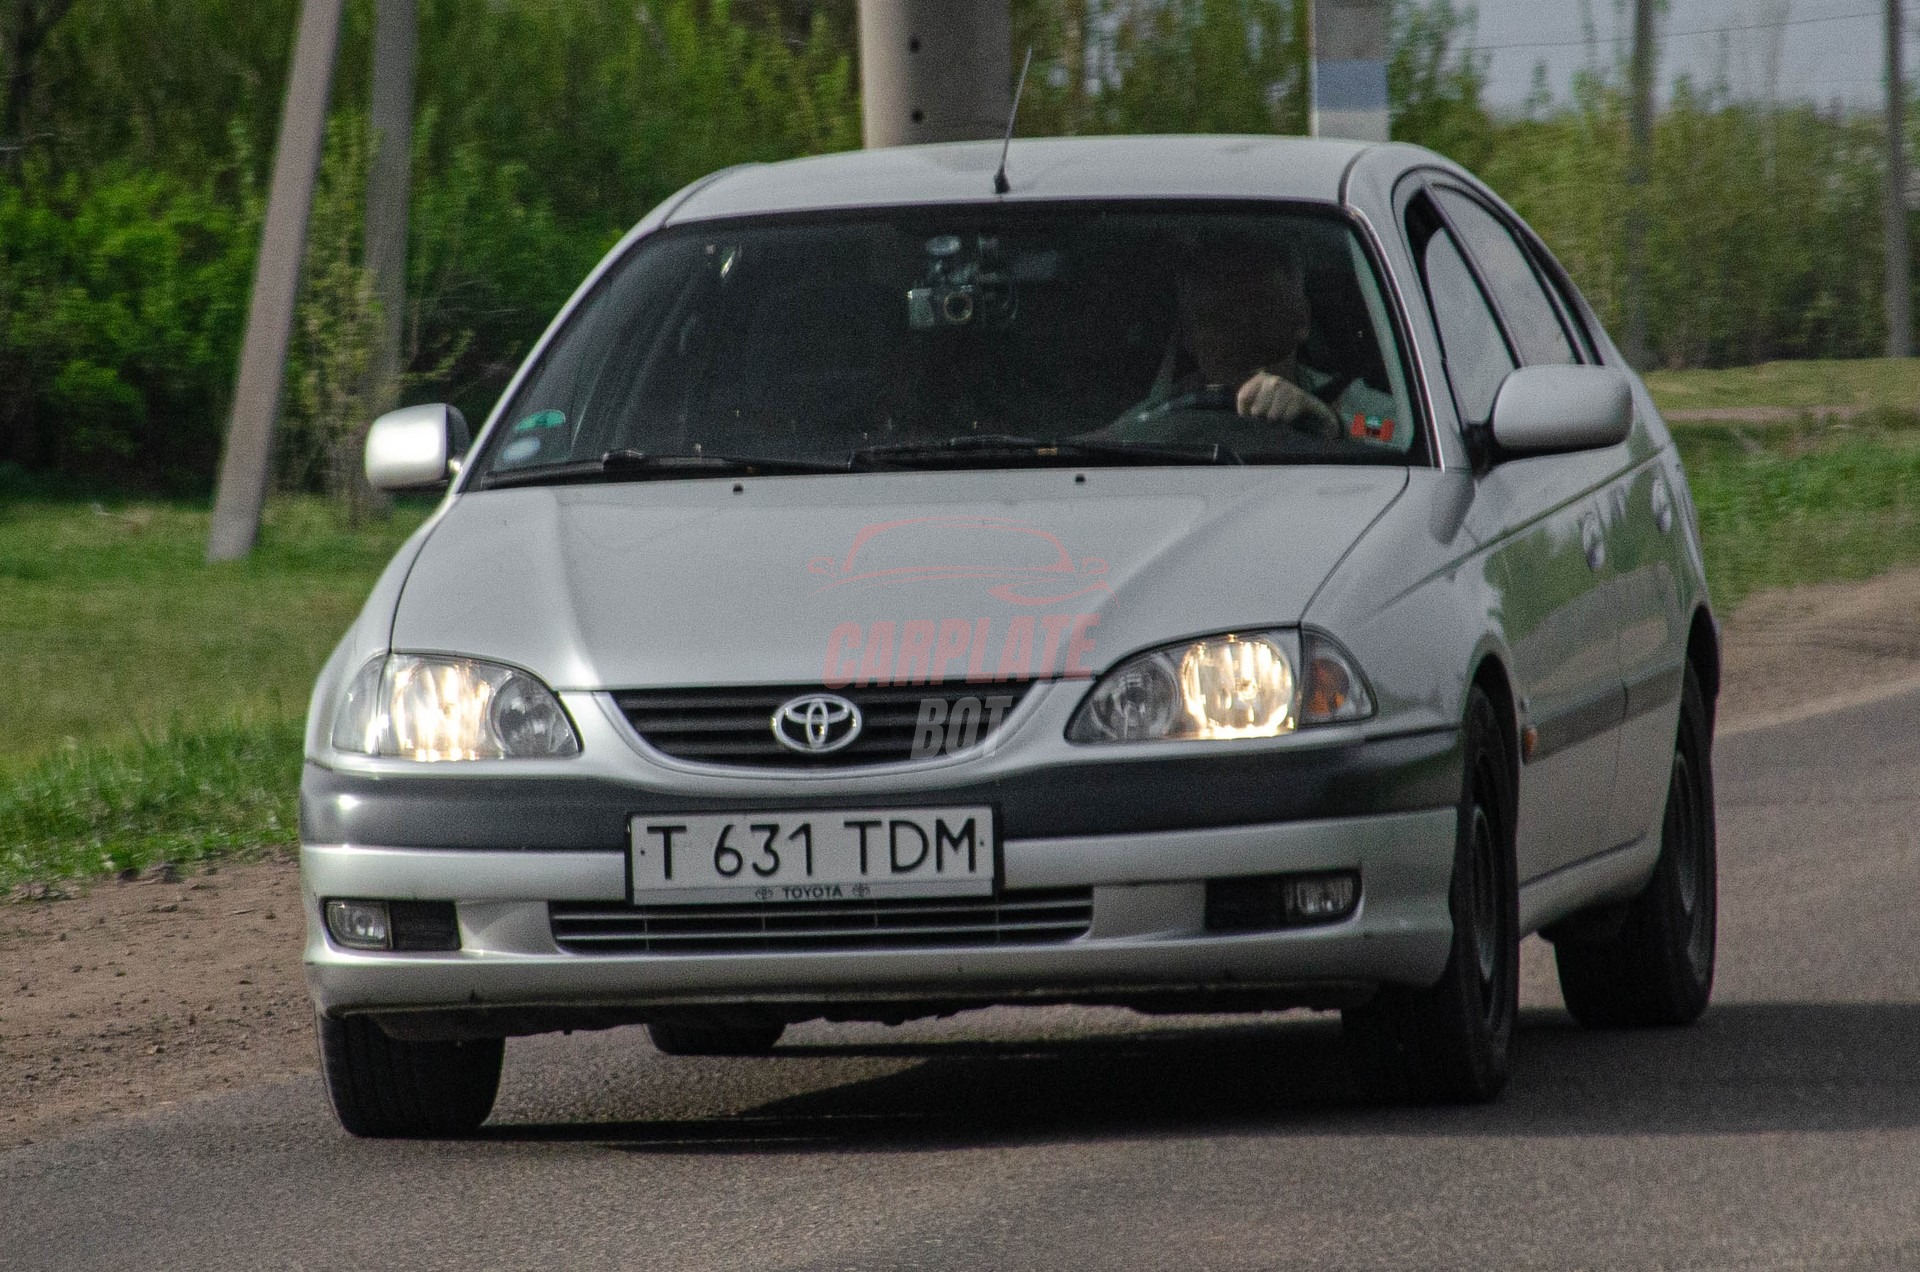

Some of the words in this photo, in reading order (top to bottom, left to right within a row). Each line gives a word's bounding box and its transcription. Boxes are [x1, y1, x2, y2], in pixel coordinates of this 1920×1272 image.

[646, 824, 687, 880] T
[713, 823, 813, 878] 631
[843, 818, 977, 875] TDM
[781, 885, 844, 900] TOYOTA
